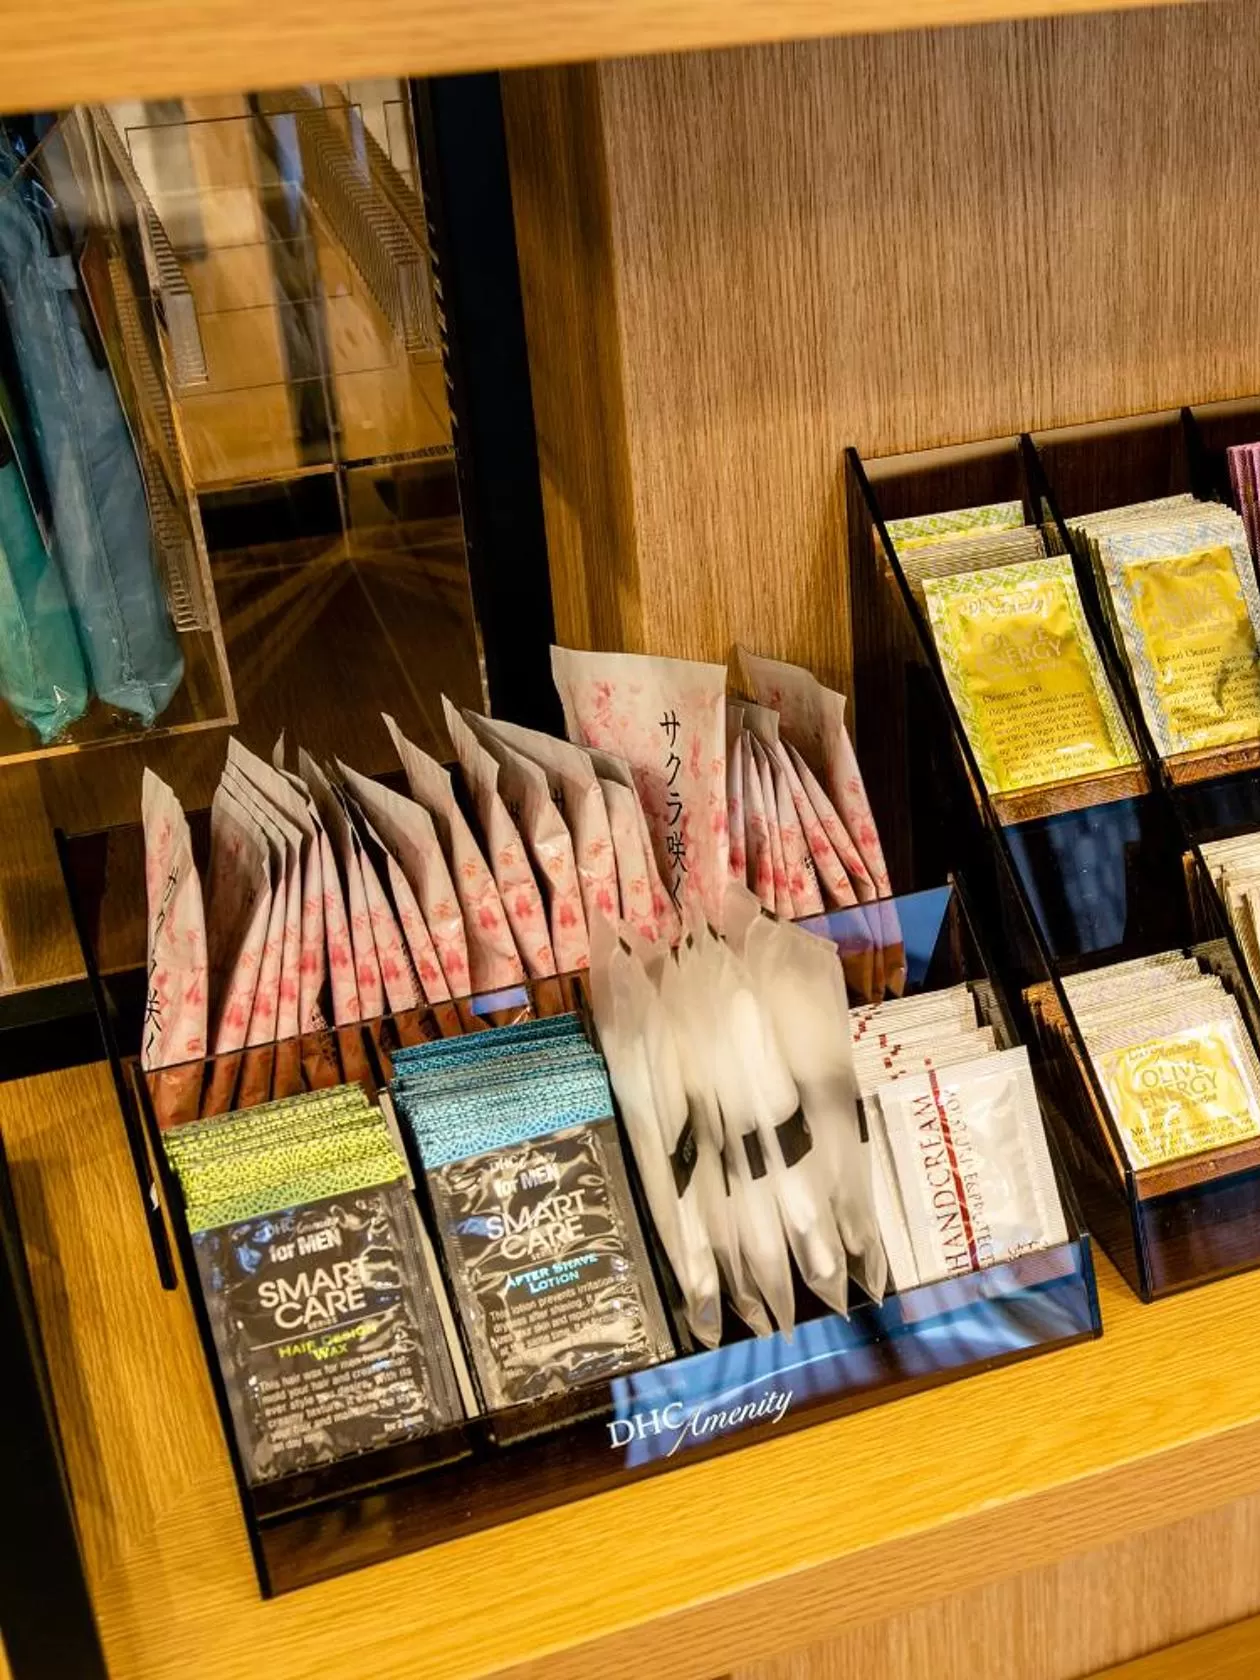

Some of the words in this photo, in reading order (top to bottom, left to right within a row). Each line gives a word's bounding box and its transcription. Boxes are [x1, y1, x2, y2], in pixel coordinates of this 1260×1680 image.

[660, 710, 687, 912] サクラ咲く
[913, 1094, 970, 1273] HANDCREAM
[486, 1189, 586, 1240] SMART
[269, 1242, 295, 1263] for
[298, 1227, 342, 1256] MEN
[501, 1216, 586, 1260] CARE
[258, 1256, 369, 1309] SMART
[508, 1266, 550, 1287] AFTER
[551, 1252, 598, 1274] SHAVE
[528, 1271, 580, 1293] LOTION
[274, 1285, 367, 1330] CARE
[278, 1339, 316, 1358] HAIR
[312, 1342, 348, 1361] WAX
[606, 1401, 683, 1448] DHC
[667, 1390, 793, 1457] Amenity
